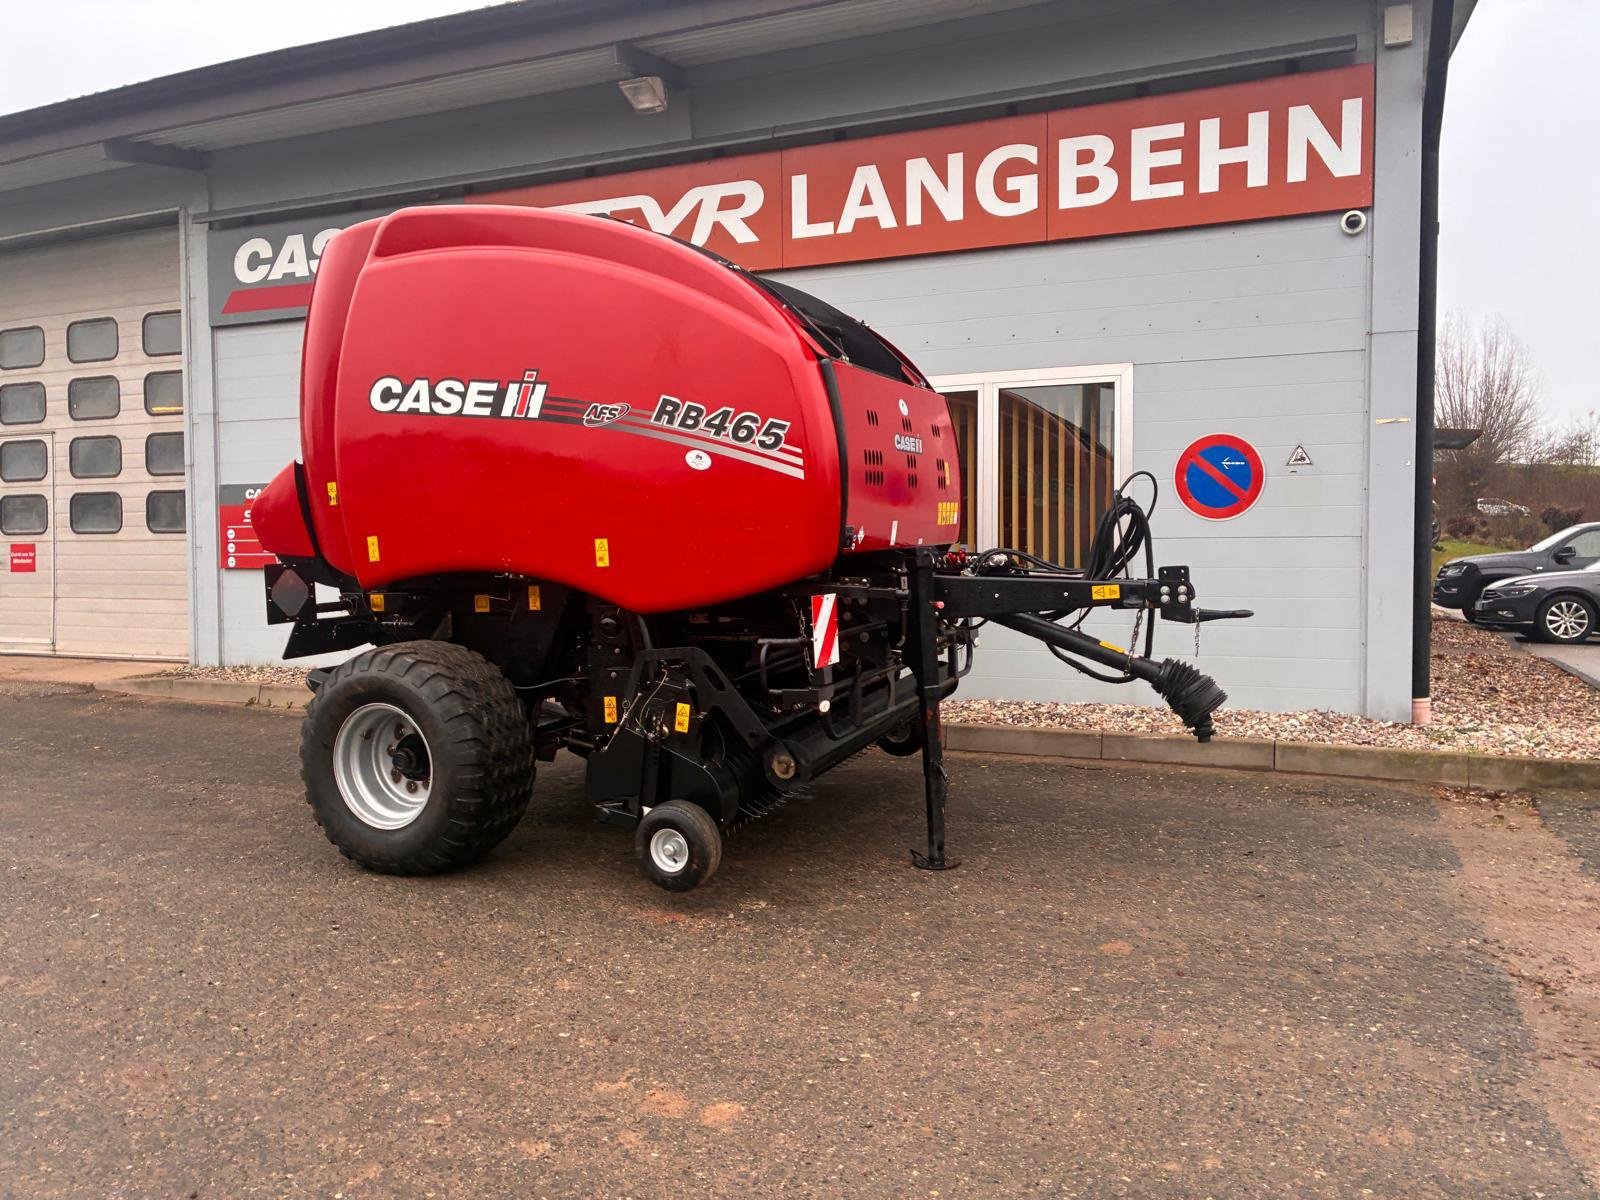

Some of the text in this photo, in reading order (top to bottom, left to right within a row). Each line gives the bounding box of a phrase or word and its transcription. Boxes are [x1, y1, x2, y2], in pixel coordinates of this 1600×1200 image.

[790, 97, 1363, 240] LANGBEHN
[369, 376, 499, 417] CASE
[584, 403, 621, 422] AFS
[650, 394, 791, 452] RB465
[894, 434, 916, 452] CASE
